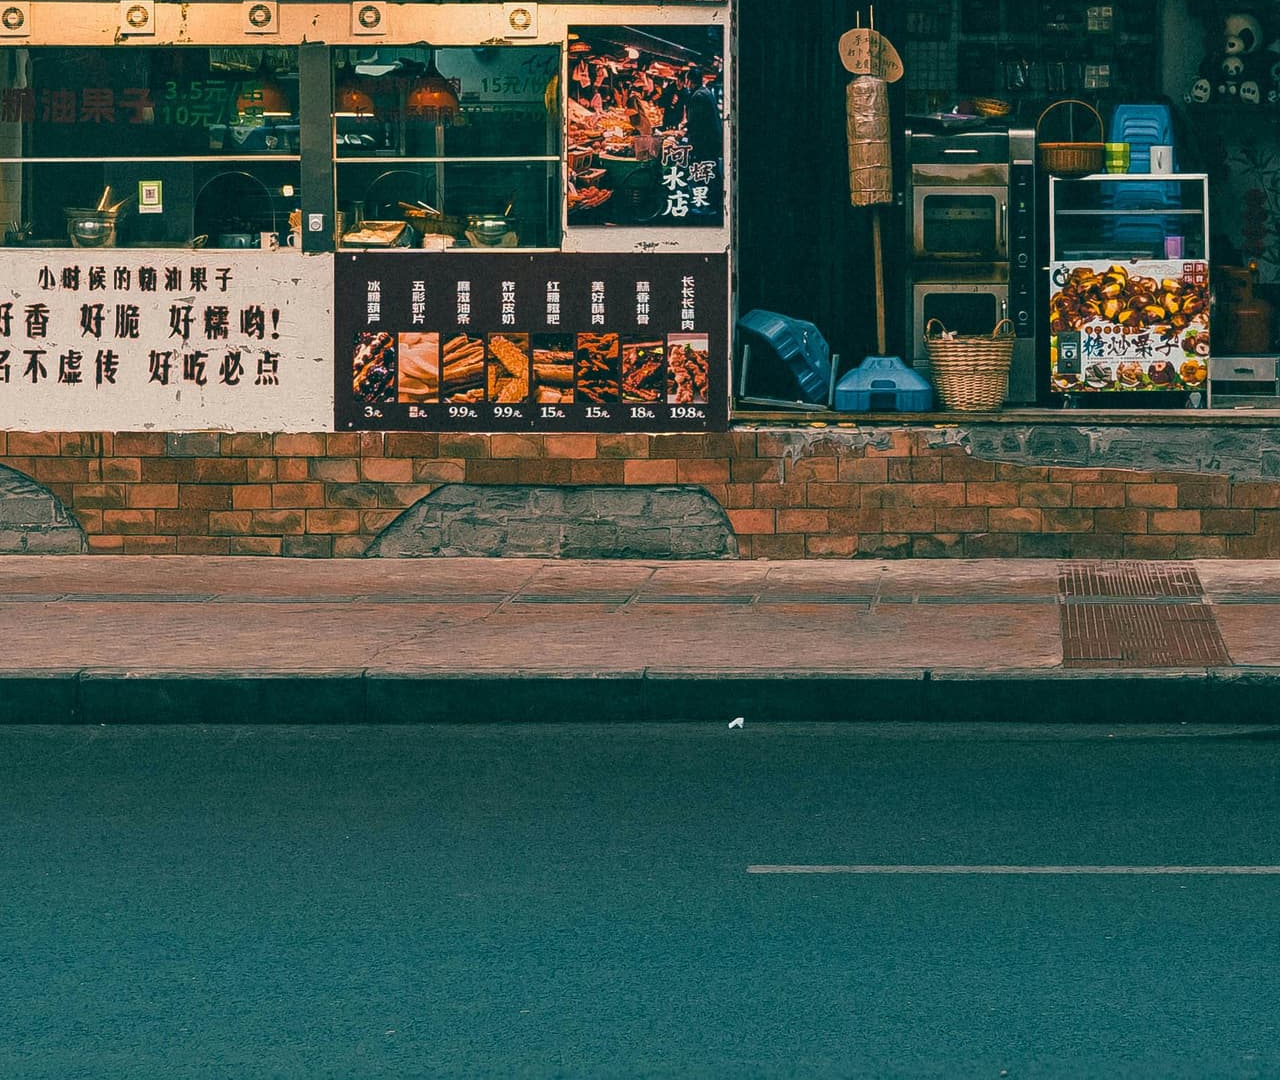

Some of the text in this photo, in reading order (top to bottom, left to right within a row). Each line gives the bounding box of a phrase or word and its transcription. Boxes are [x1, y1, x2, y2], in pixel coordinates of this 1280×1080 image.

[37, 265, 234, 292] 小时候的糖油果子
[80, 303, 141, 339] 好脆
[148, 350, 280, 386] 好吃必点
